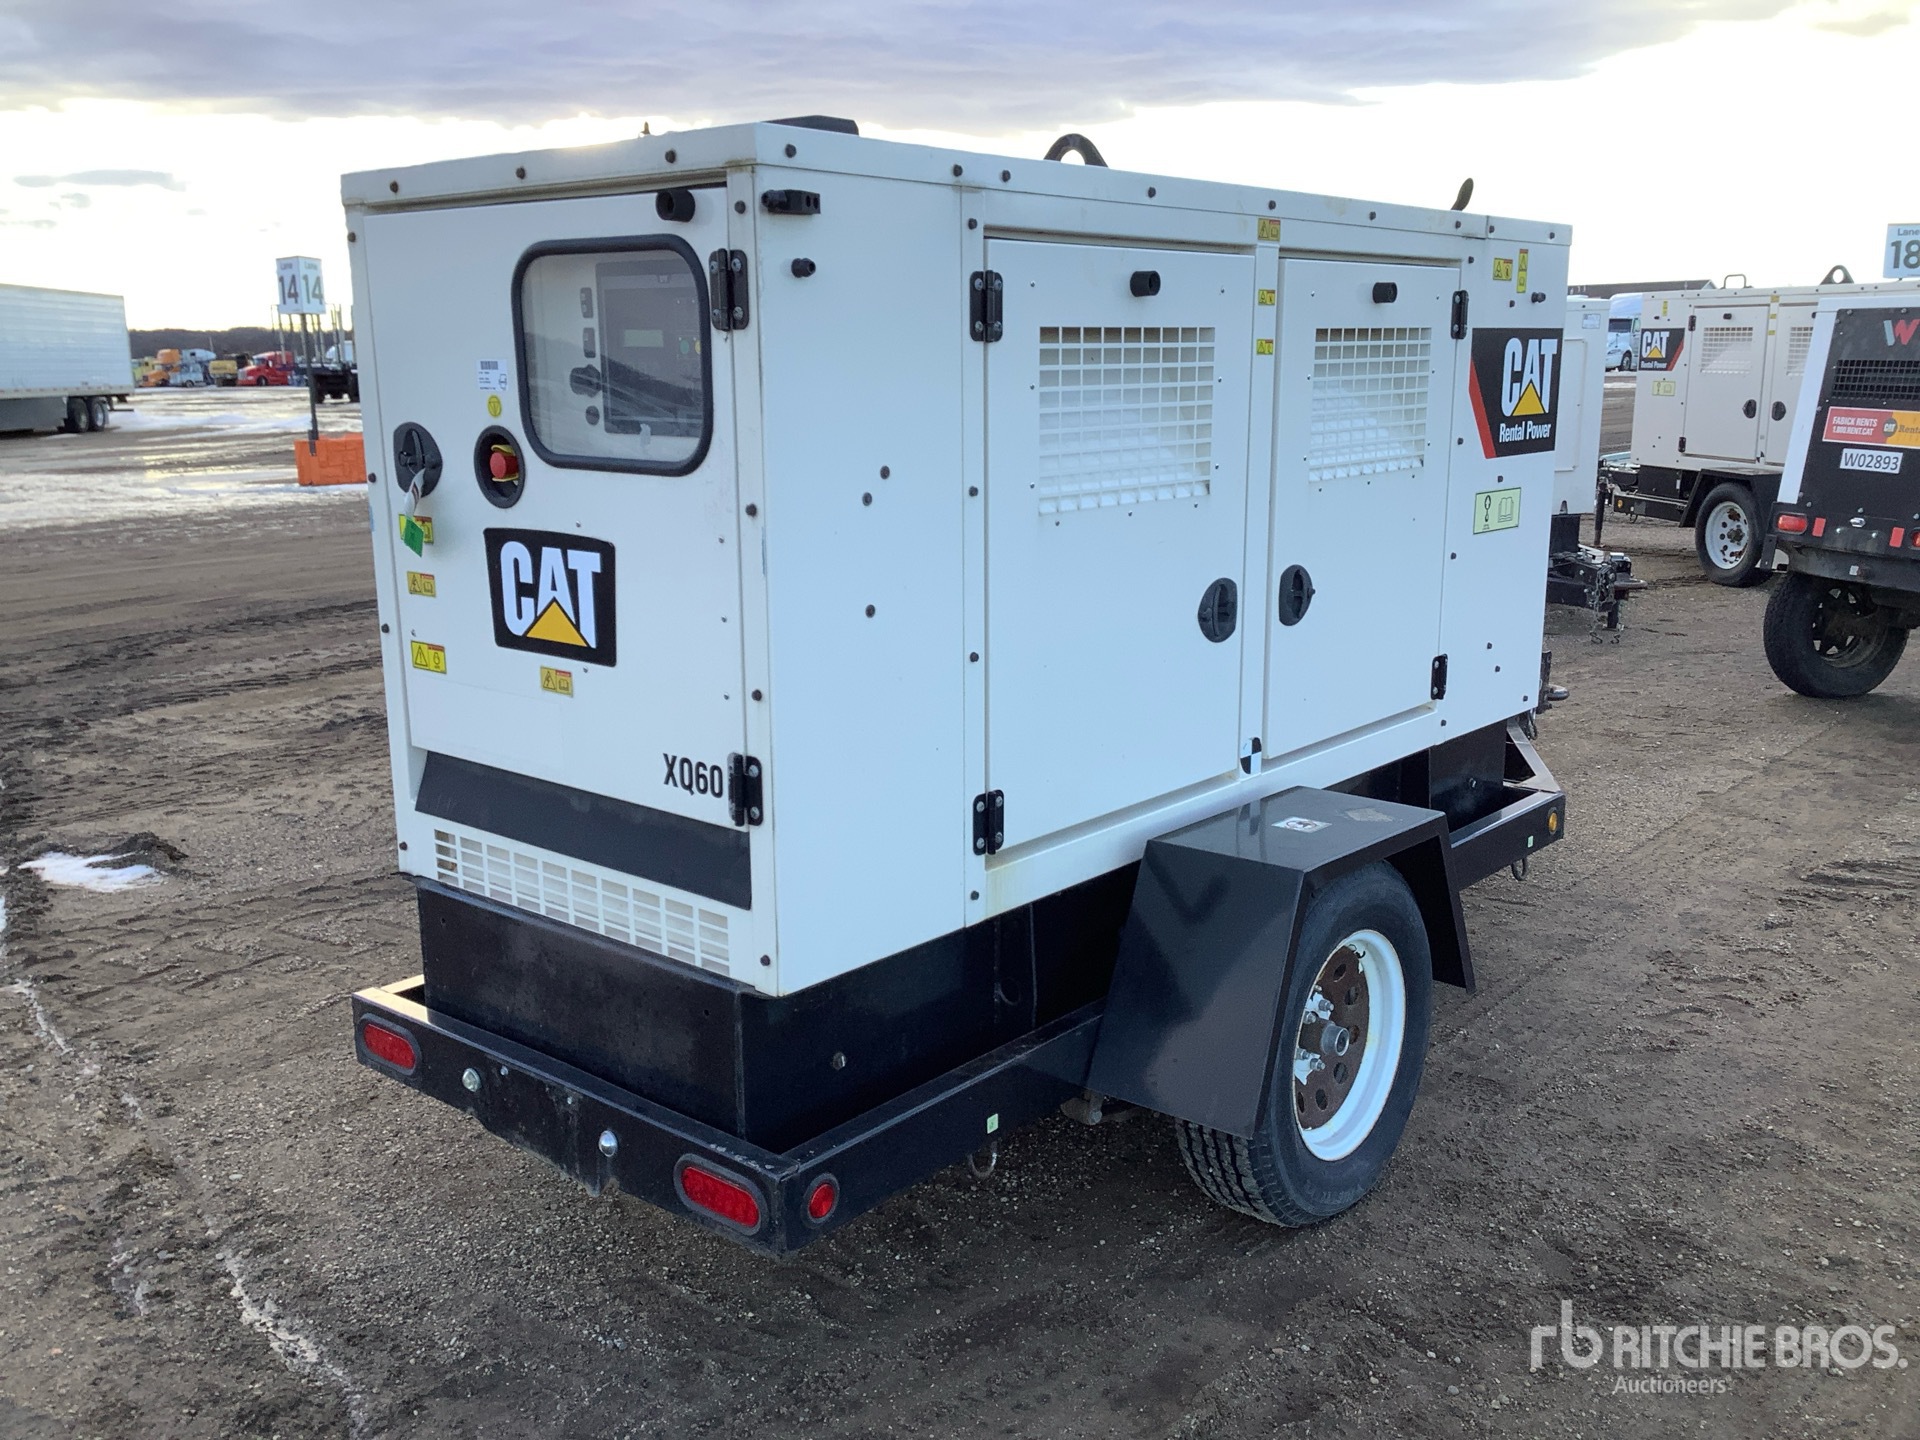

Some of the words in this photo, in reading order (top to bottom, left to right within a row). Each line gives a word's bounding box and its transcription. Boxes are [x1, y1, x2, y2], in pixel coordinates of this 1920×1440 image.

[1897, 227, 1920, 236] Lane
[1891, 239, 1920, 269] 18
[279, 274, 299, 305] 14
[303, 274, 323, 305] 14
[1641, 330, 1670, 358] CAT
[1501, 337, 1558, 417] CAT
[1499, 421, 1525, 443] Rental
[1526, 420, 1552, 440] Power
[1856, 417, 1878, 428] RENTS
[1844, 452, 1899, 471] W02893
[500, 540, 602, 649] CAT
[662, 752, 724, 799] XQ60
